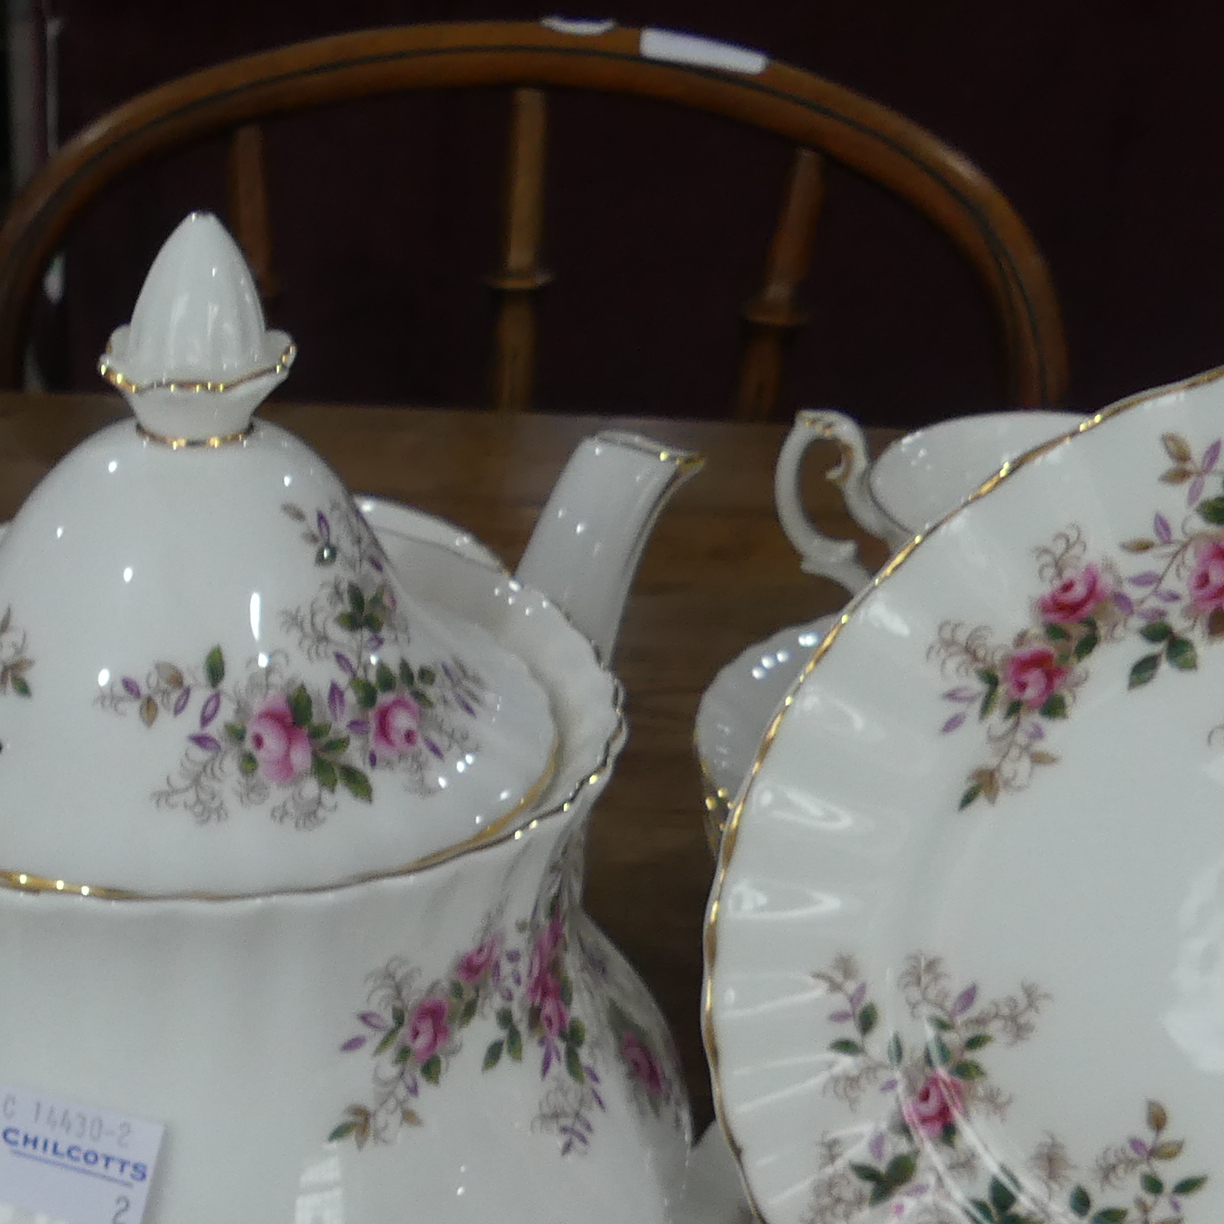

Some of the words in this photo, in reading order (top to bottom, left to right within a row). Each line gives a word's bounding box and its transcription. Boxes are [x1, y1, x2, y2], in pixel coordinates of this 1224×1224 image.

[2, 1094, 16, 1120] C
[34, 1102, 132, 1148] 14430-2
[2, 1127, 148, 1182] CHILCOTTS
